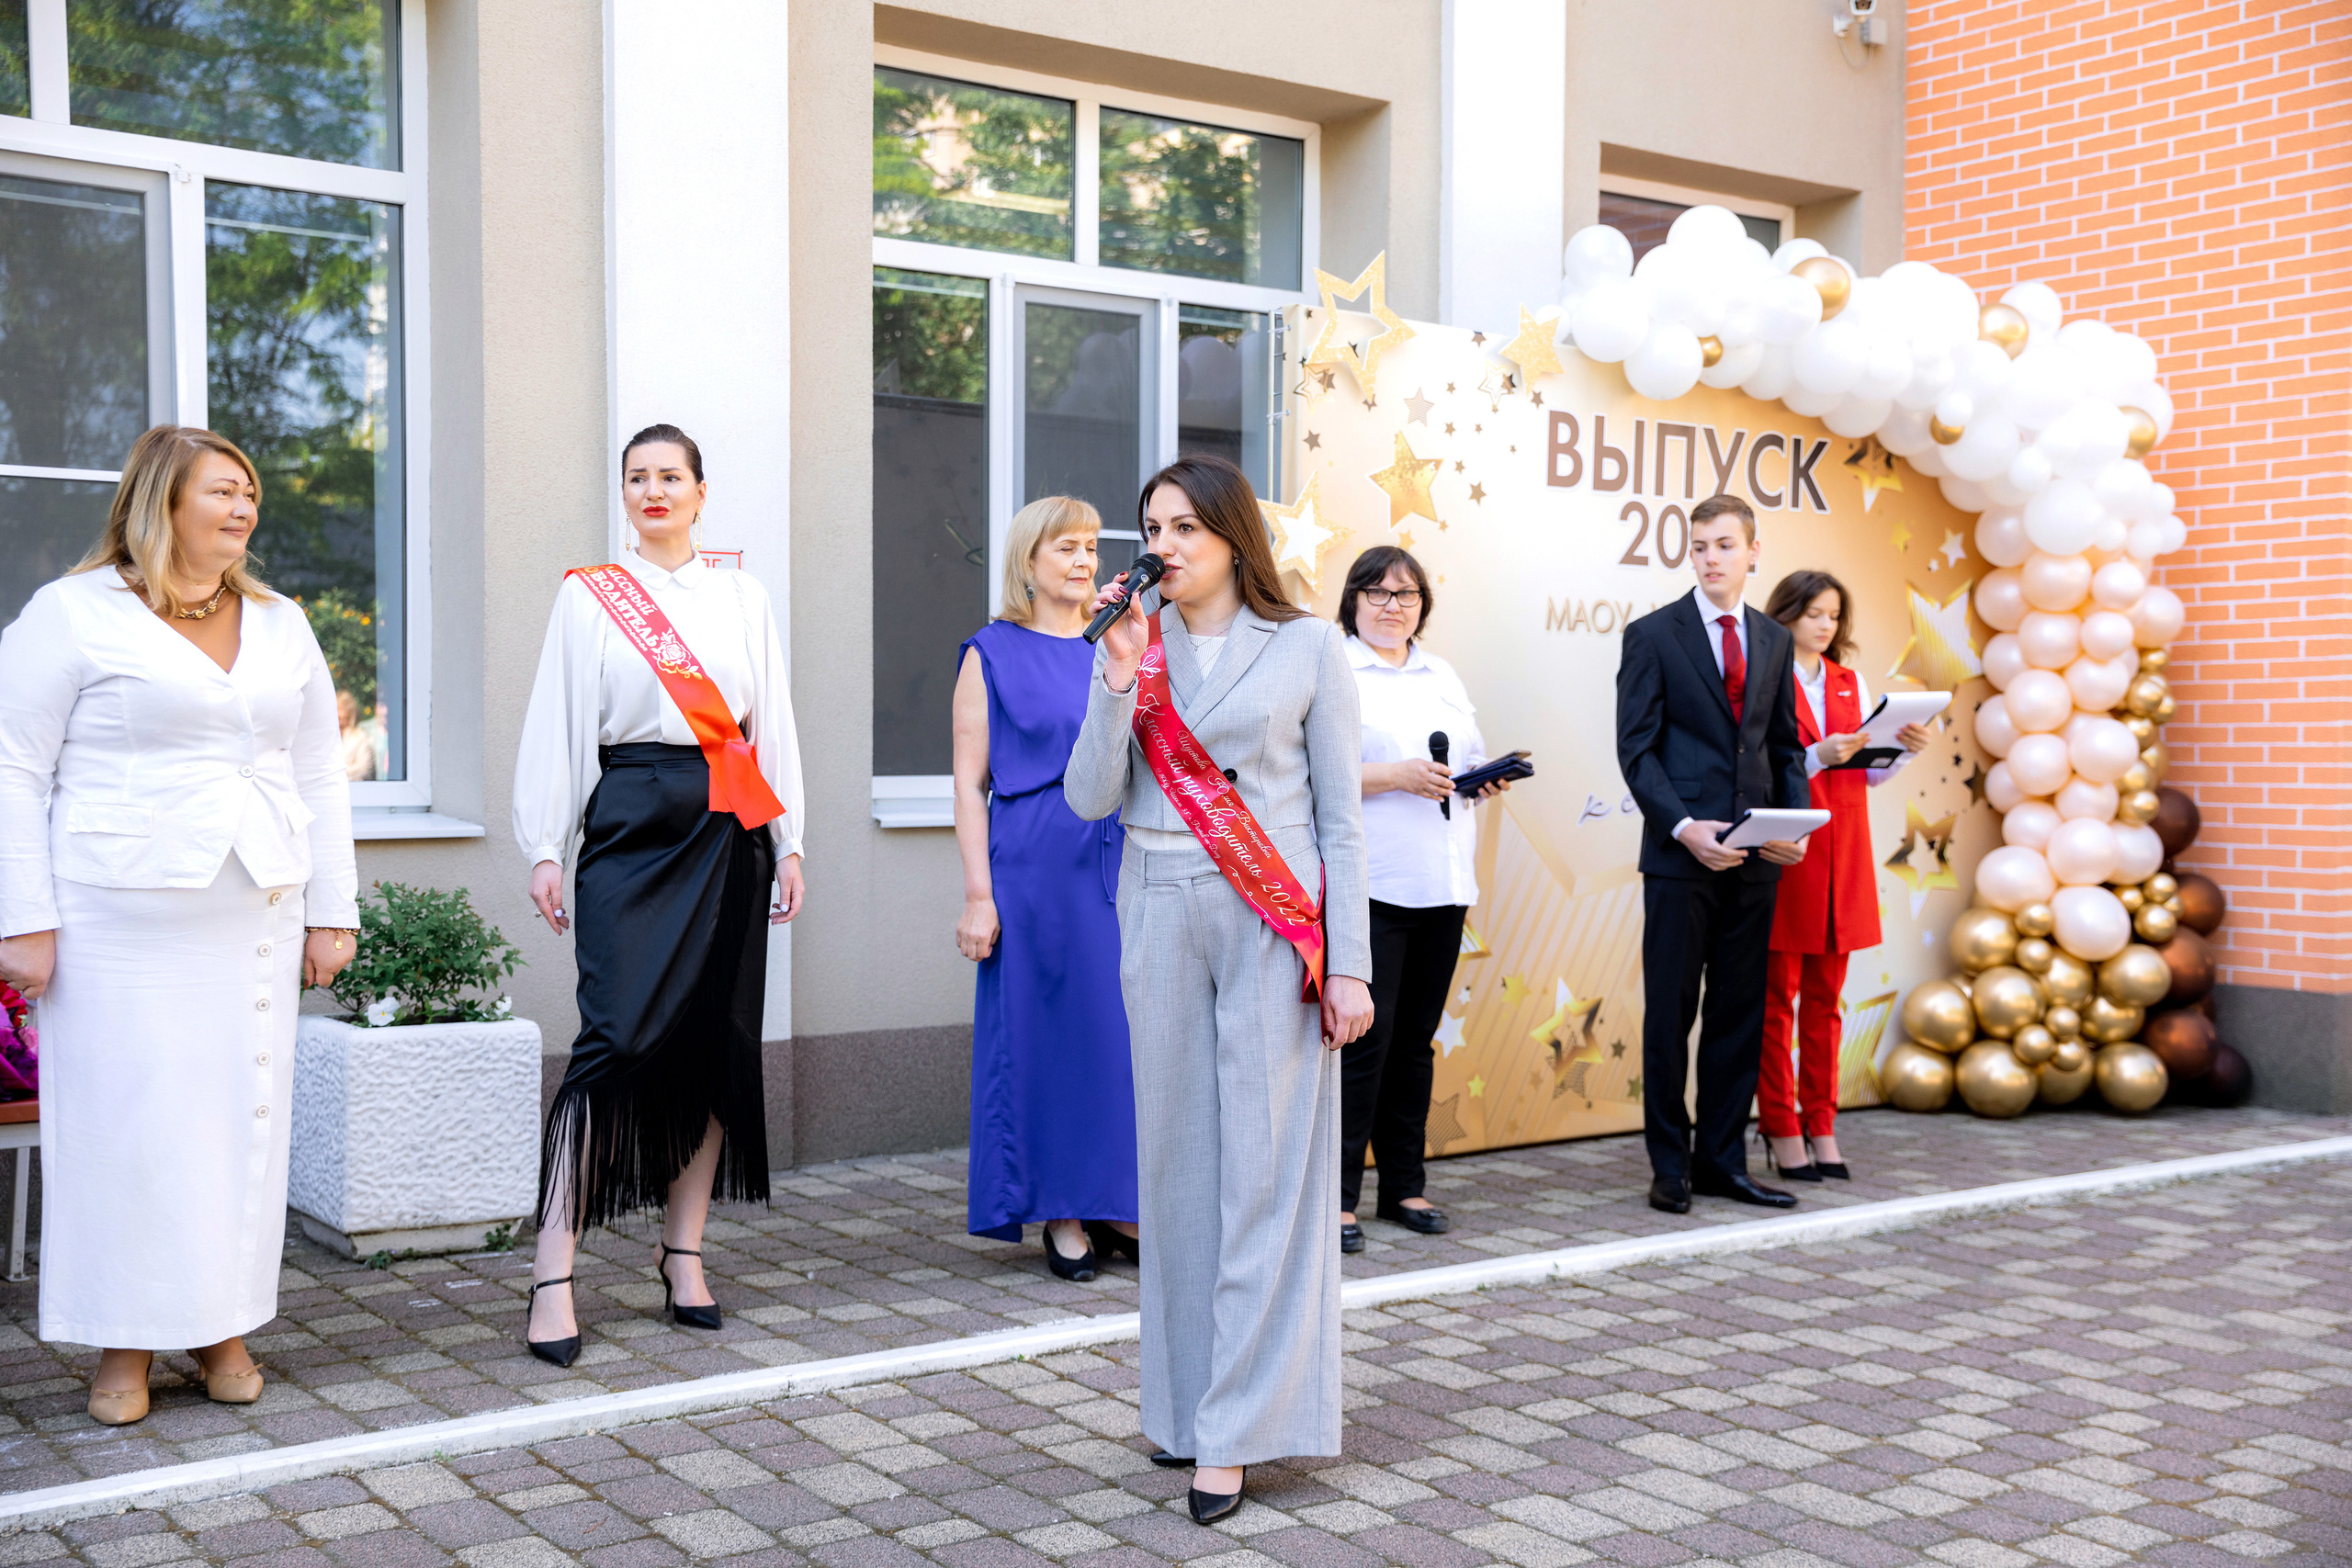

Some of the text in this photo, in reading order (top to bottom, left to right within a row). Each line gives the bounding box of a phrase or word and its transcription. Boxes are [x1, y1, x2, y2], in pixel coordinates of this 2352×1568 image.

[1545, 409, 1830, 513] ВЫПУСК
[1617, 500, 1758, 577] 20
[1545, 596, 1633, 634] МАОУ
[1136, 693, 1306, 926] Классный руководитель 2022
[1207, 774, 1235, 807] Юлия
[1236, 810, 1274, 859] Викторовна
